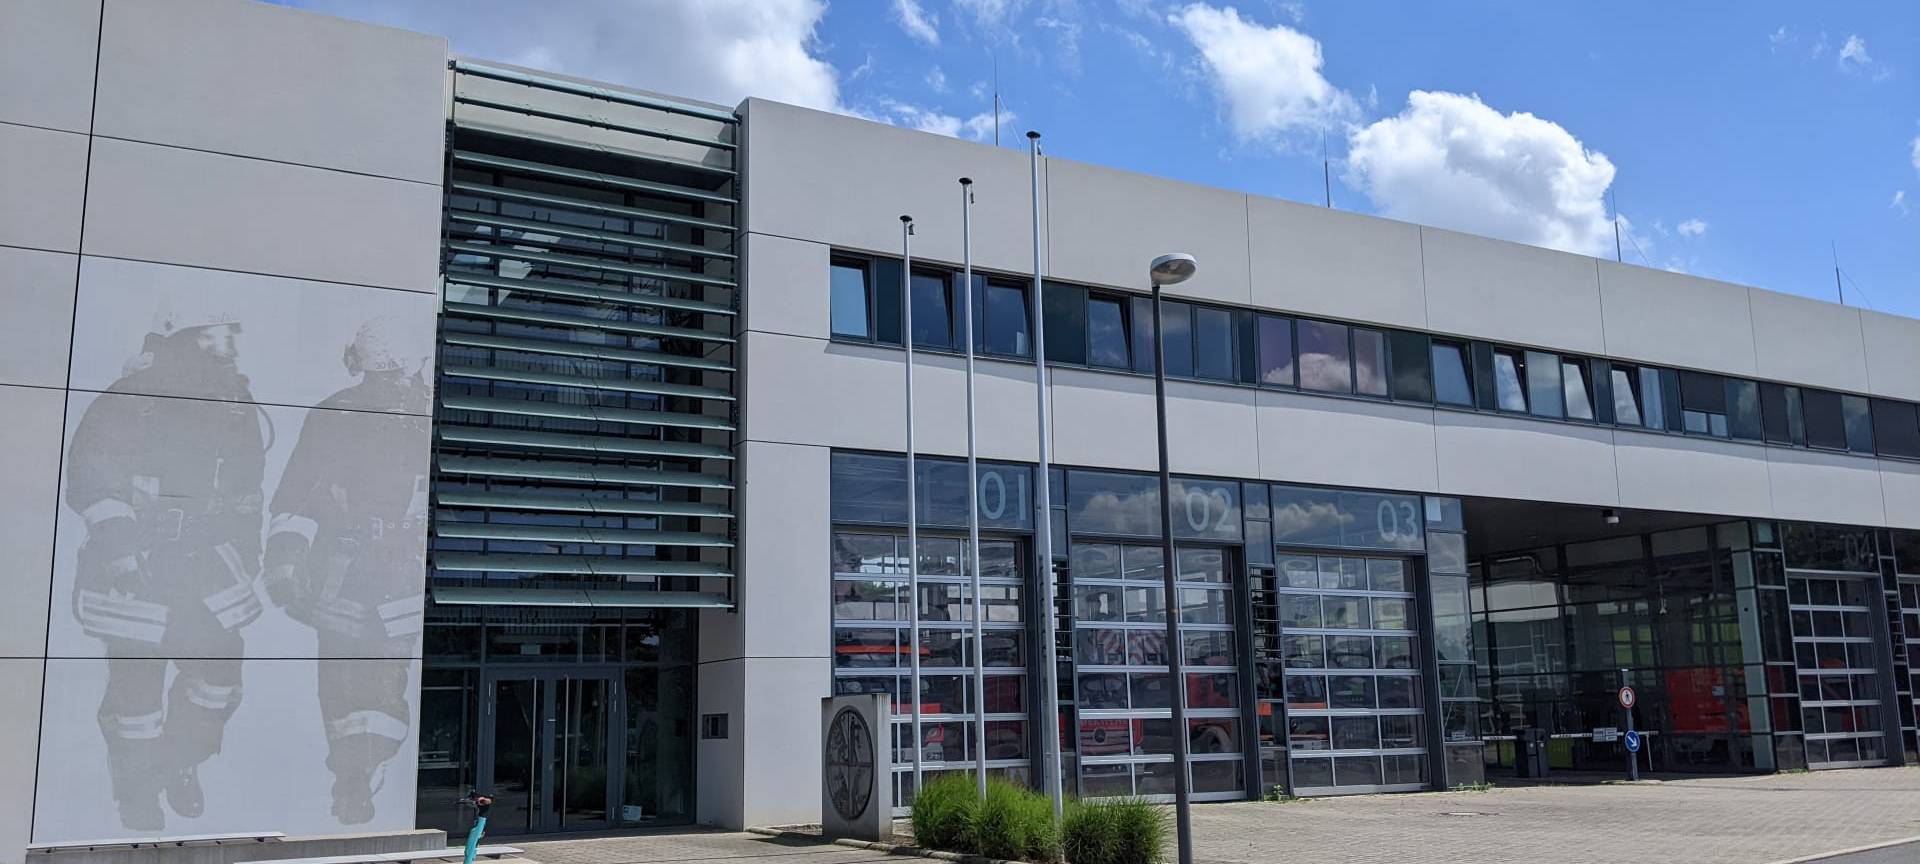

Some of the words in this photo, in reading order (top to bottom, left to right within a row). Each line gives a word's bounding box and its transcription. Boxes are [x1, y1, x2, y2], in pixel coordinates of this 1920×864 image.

[979, 471, 1026, 520] 01
[1185, 487, 1236, 531] 02
[1377, 500, 1418, 542] 03
